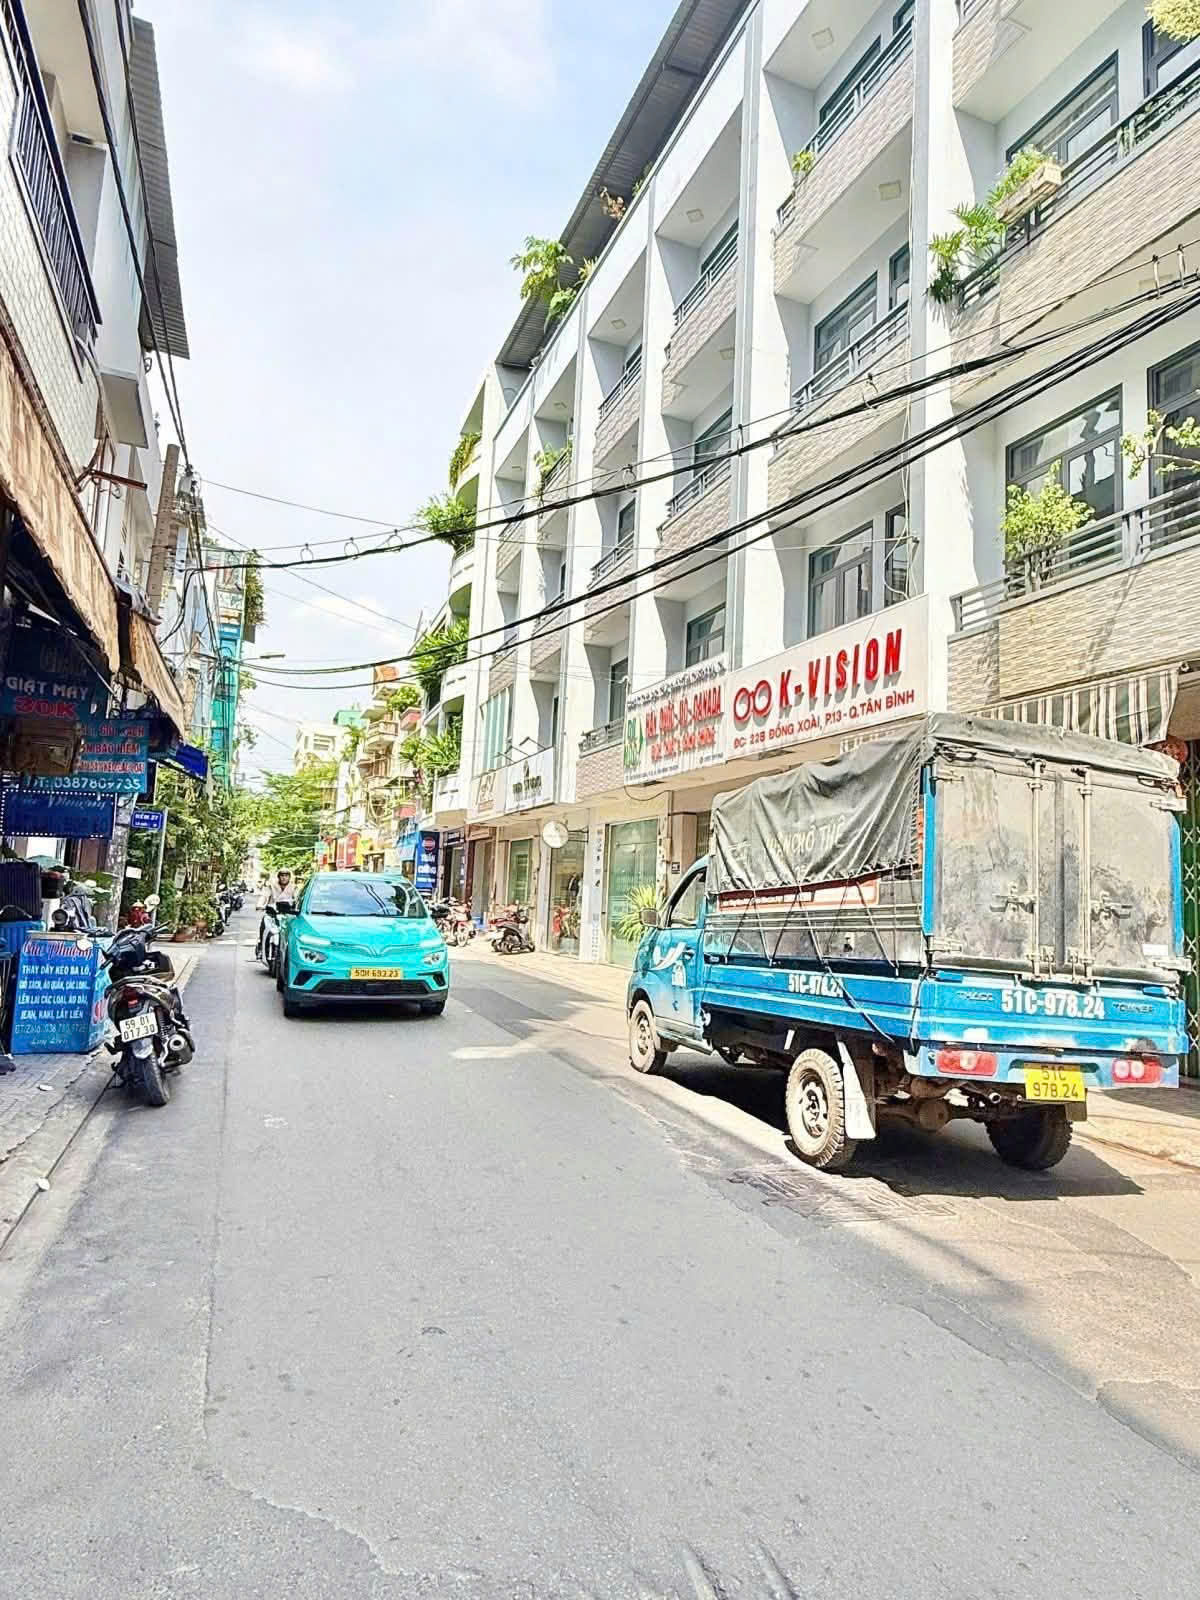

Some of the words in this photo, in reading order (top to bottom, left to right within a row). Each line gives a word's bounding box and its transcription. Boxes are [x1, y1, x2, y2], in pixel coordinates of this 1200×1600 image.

[779, 628, 902, 708] K-VISION
[798, 714, 823, 733] XOÀI,
[885, 689, 915, 710] BÌNH
[1000, 989, 1106, 1020] 51C-978.24
[1041, 1065, 1067, 1081] 51C
